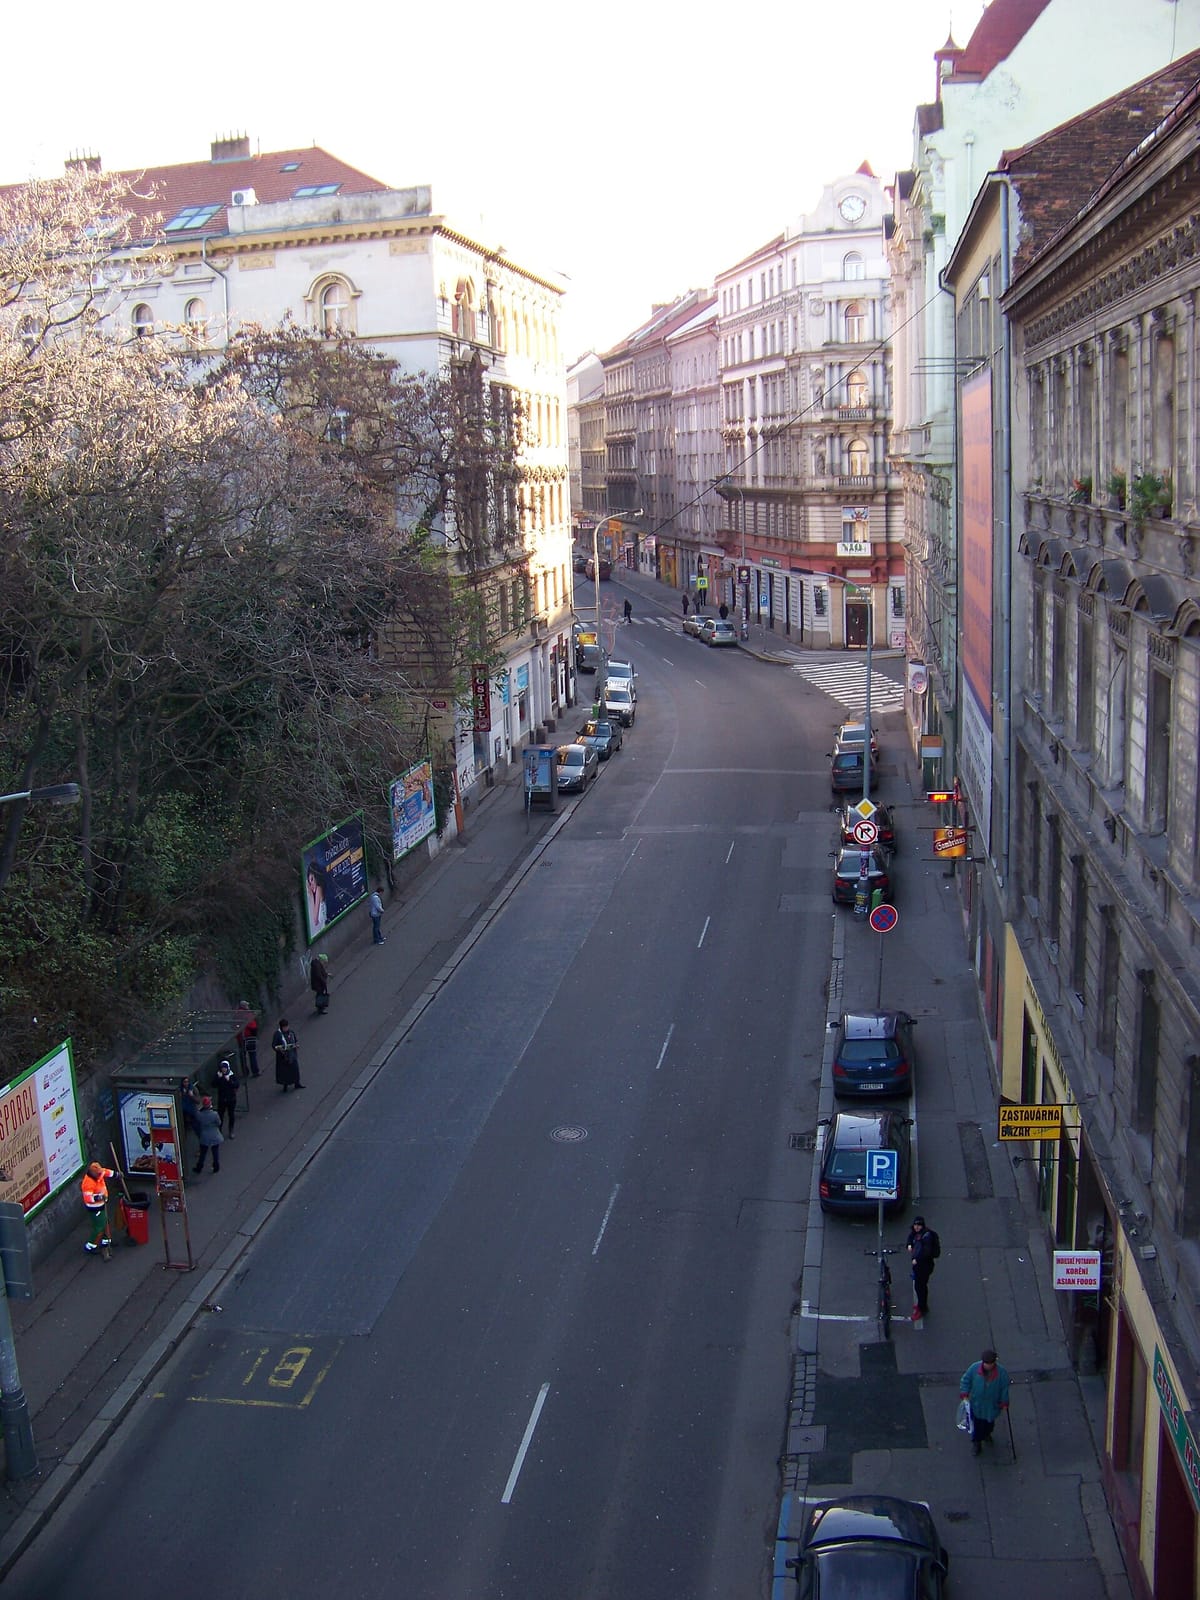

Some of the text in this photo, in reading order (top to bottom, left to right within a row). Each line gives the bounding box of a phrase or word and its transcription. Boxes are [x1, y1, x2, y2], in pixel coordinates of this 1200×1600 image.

[476, 668, 486, 719] HOSTEL
[1002, 1108, 1060, 1121] ZASTAVÁRNA
[872, 1154, 890, 1177] P
[1057, 1277, 1097, 1285] ASIAN FOODS
